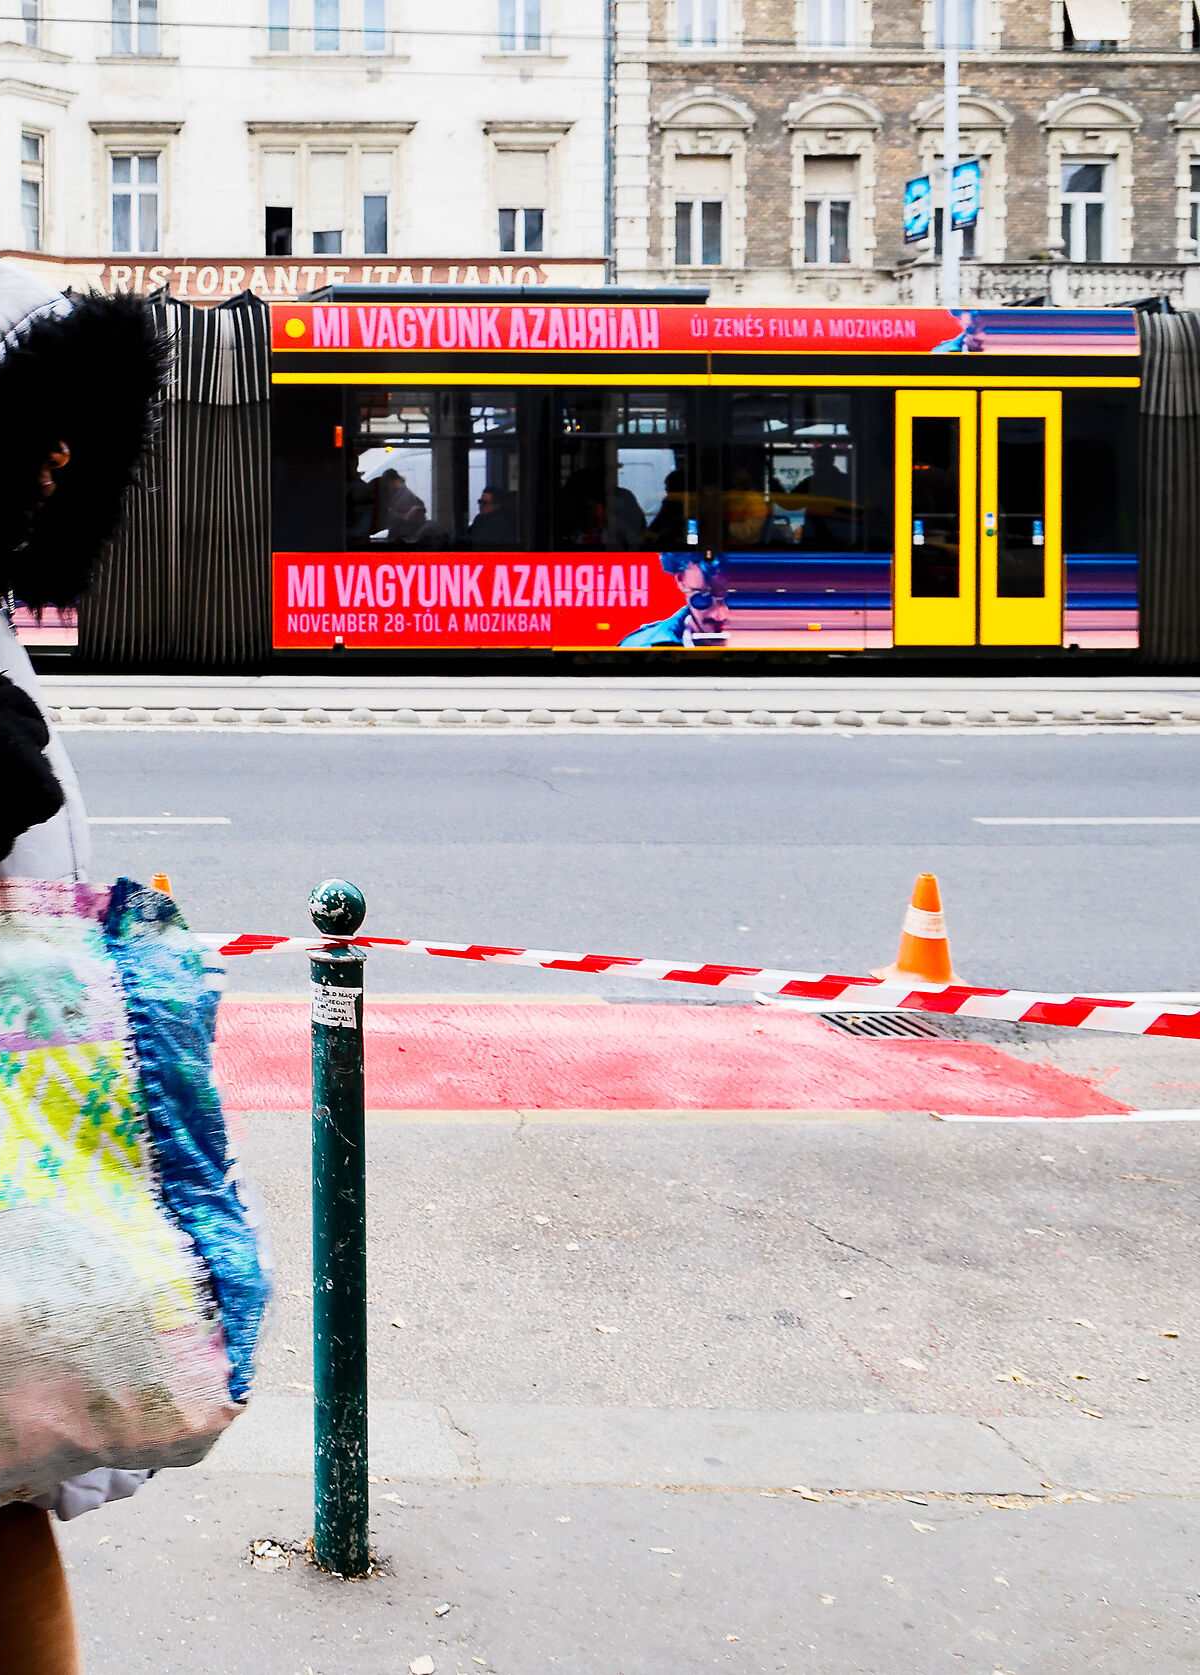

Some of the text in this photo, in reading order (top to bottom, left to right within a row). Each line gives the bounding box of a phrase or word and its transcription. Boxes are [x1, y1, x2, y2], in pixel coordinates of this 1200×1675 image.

[108, 265, 350, 296] RISTORANTE
[312, 306, 350, 348] MI
[356, 306, 502, 349] VAGYUNK
[690, 313, 917, 339] ÚJ ZENÉS FILM A MOZIKBAN
[287, 564, 325, 607] MI
[334, 564, 484, 607] VAGYUNK
[287, 609, 552, 633] NOVEMBER 28-TÓL A MOZIKBAN
